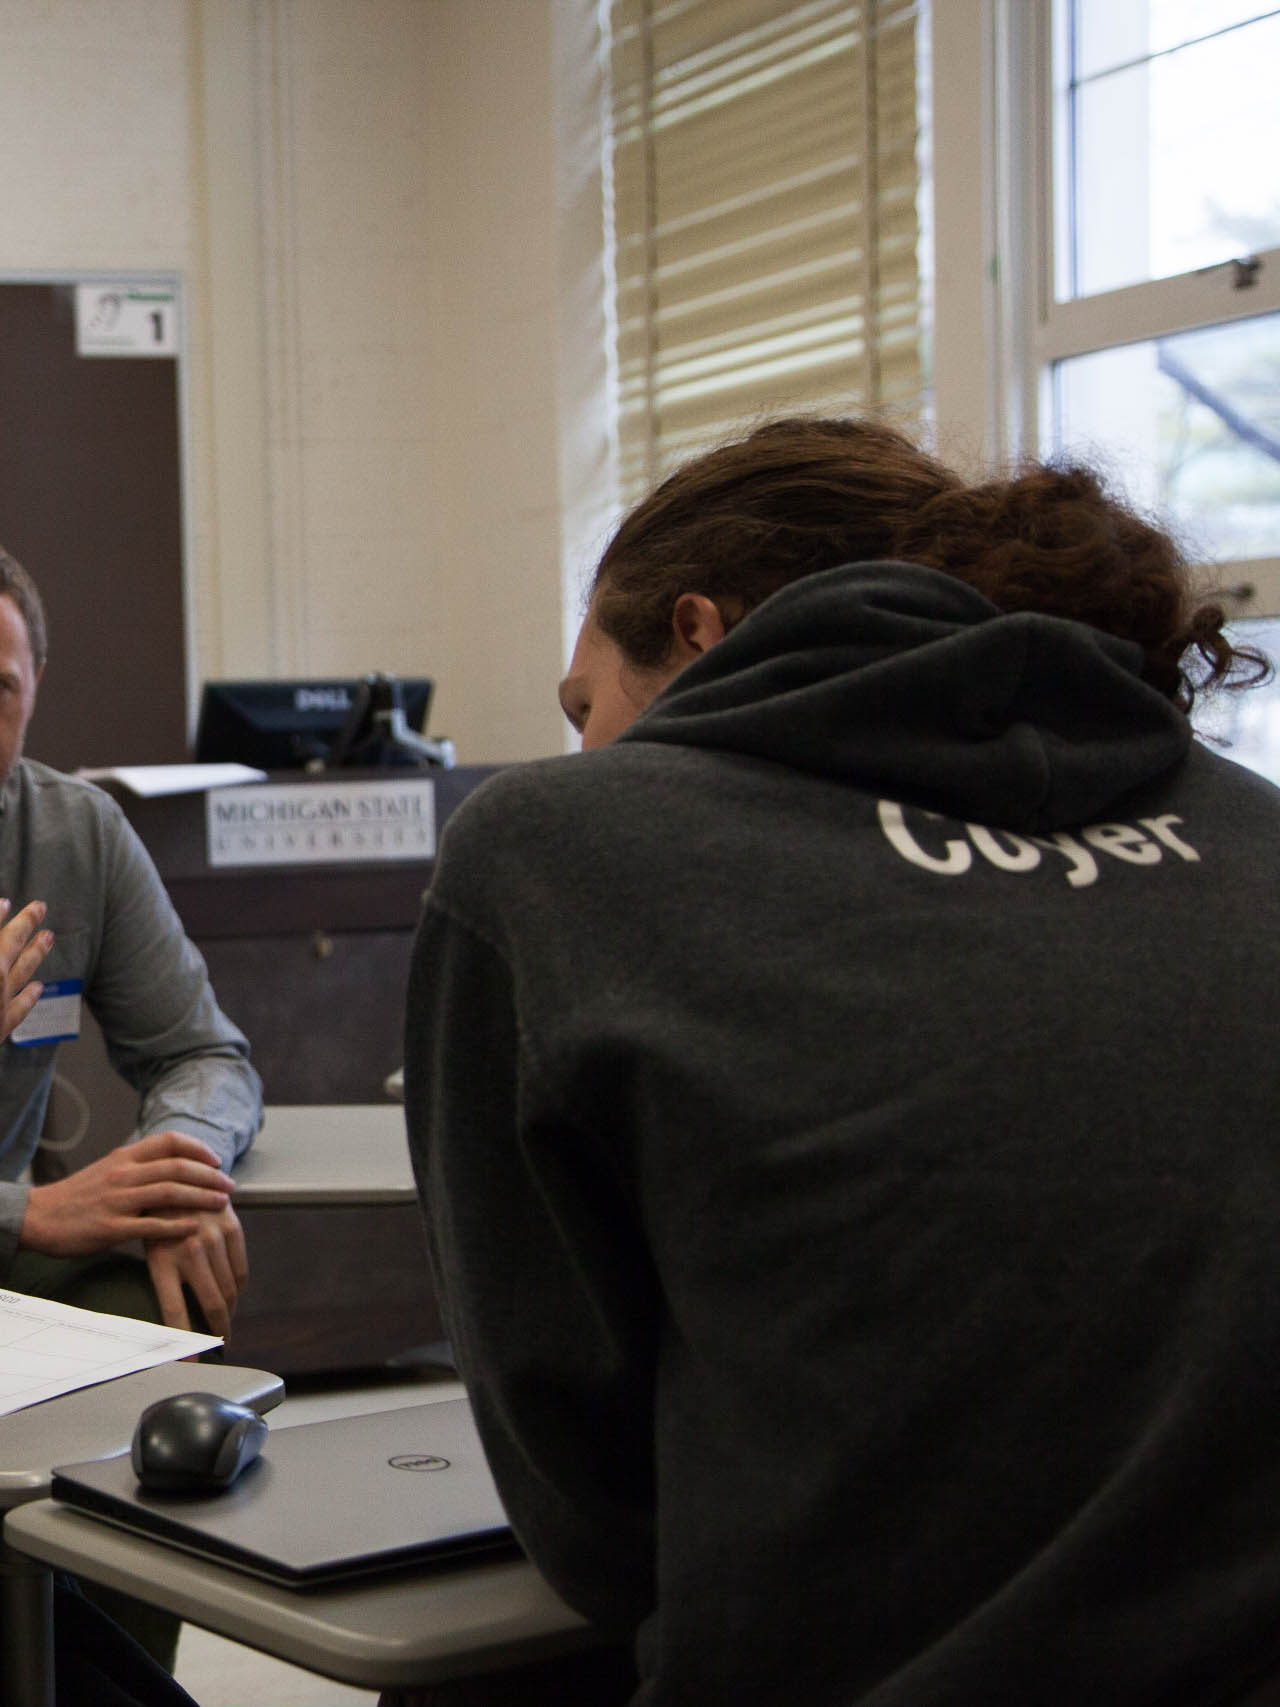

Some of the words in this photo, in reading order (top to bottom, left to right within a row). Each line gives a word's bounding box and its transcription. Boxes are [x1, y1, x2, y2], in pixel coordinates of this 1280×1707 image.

[149, 309, 163, 342] 1
[216, 797, 351, 823] MICHIGAN
[357, 793, 422, 818] STATE
